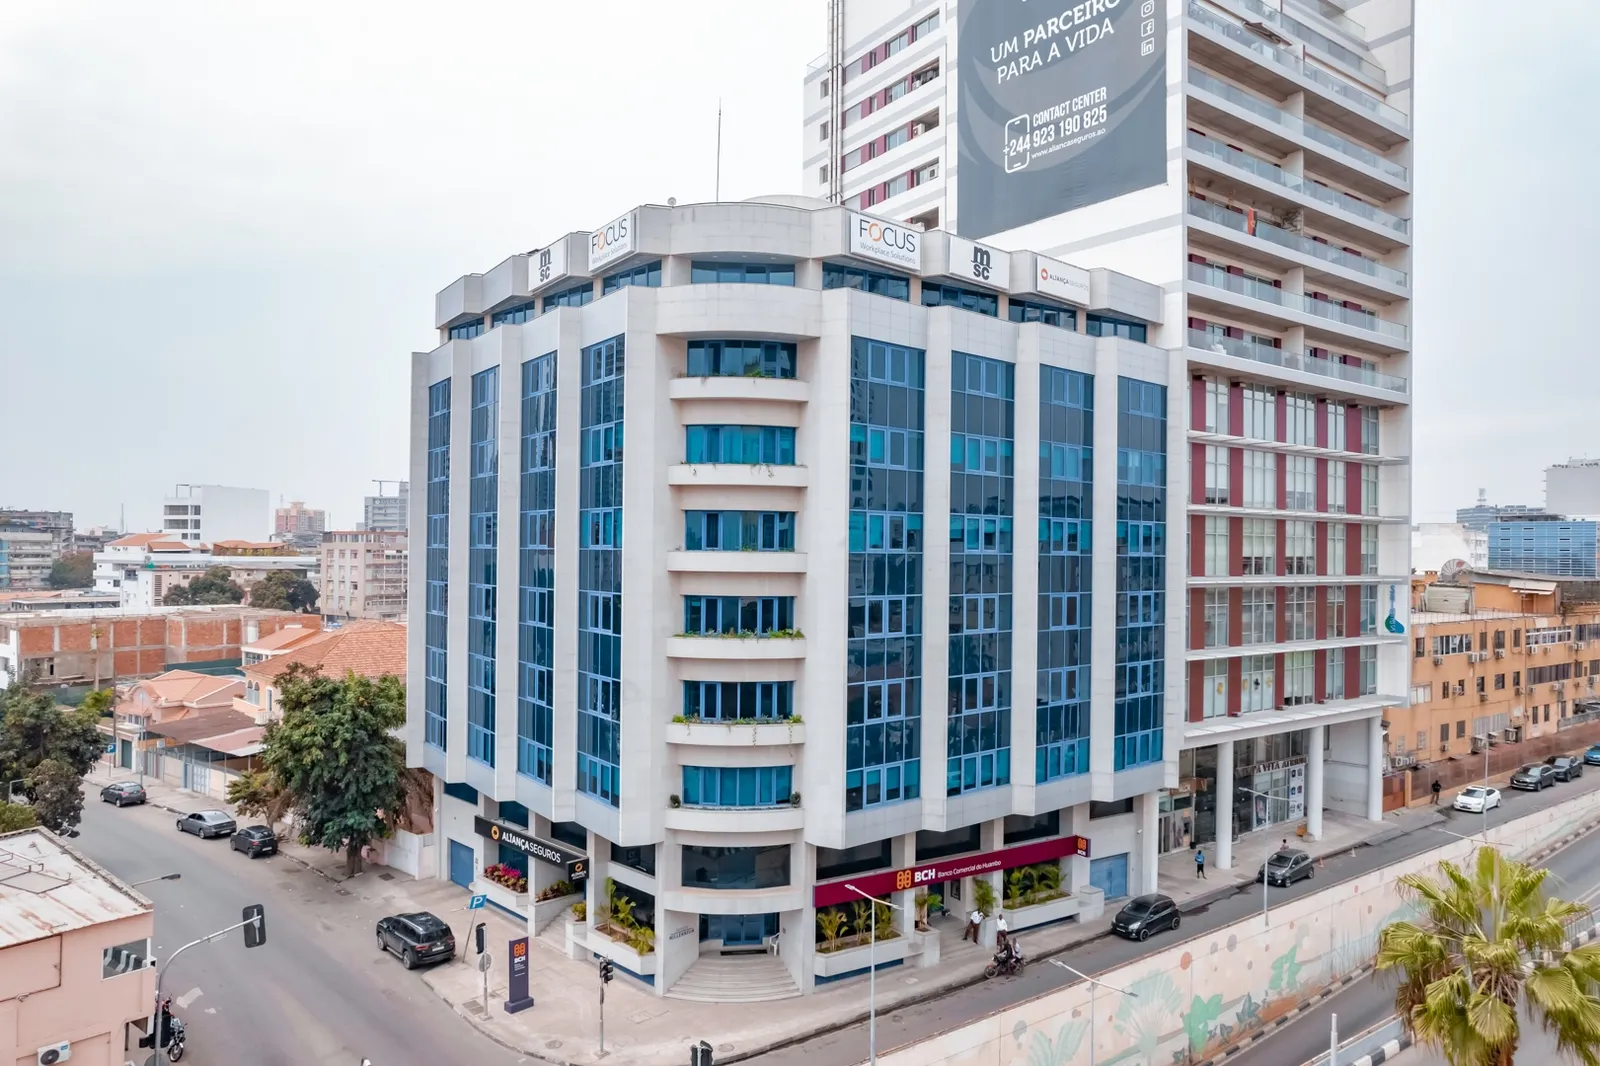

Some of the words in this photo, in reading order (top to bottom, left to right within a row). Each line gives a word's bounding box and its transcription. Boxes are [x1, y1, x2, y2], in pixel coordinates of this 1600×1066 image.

[990, 36, 1019, 63] UM
[997, 50, 1043, 84] PARA
[1047, 42, 1061, 62] A
[1065, 17, 1114, 52] VIDA
[1033, 100, 1071, 127] CONTACT
[1072, 86, 1107, 112] CENTER
[1003, 133, 1031, 156] +244
[1033, 124, 1055, 148] 923
[1059, 114, 1080, 138] 190
[1083, 104, 1107, 129] 825
[592, 218, 628, 254] FOCUS
[859, 218, 916, 253] FOCUS
[860, 240, 890, 257] Workplace
[891, 251, 916, 265] Solutions
[914, 868, 936, 882] BCH
[938, 870, 953, 878] Banco
[953, 864, 976, 875] Comercial
[982, 860, 1002, 869] Huambo
